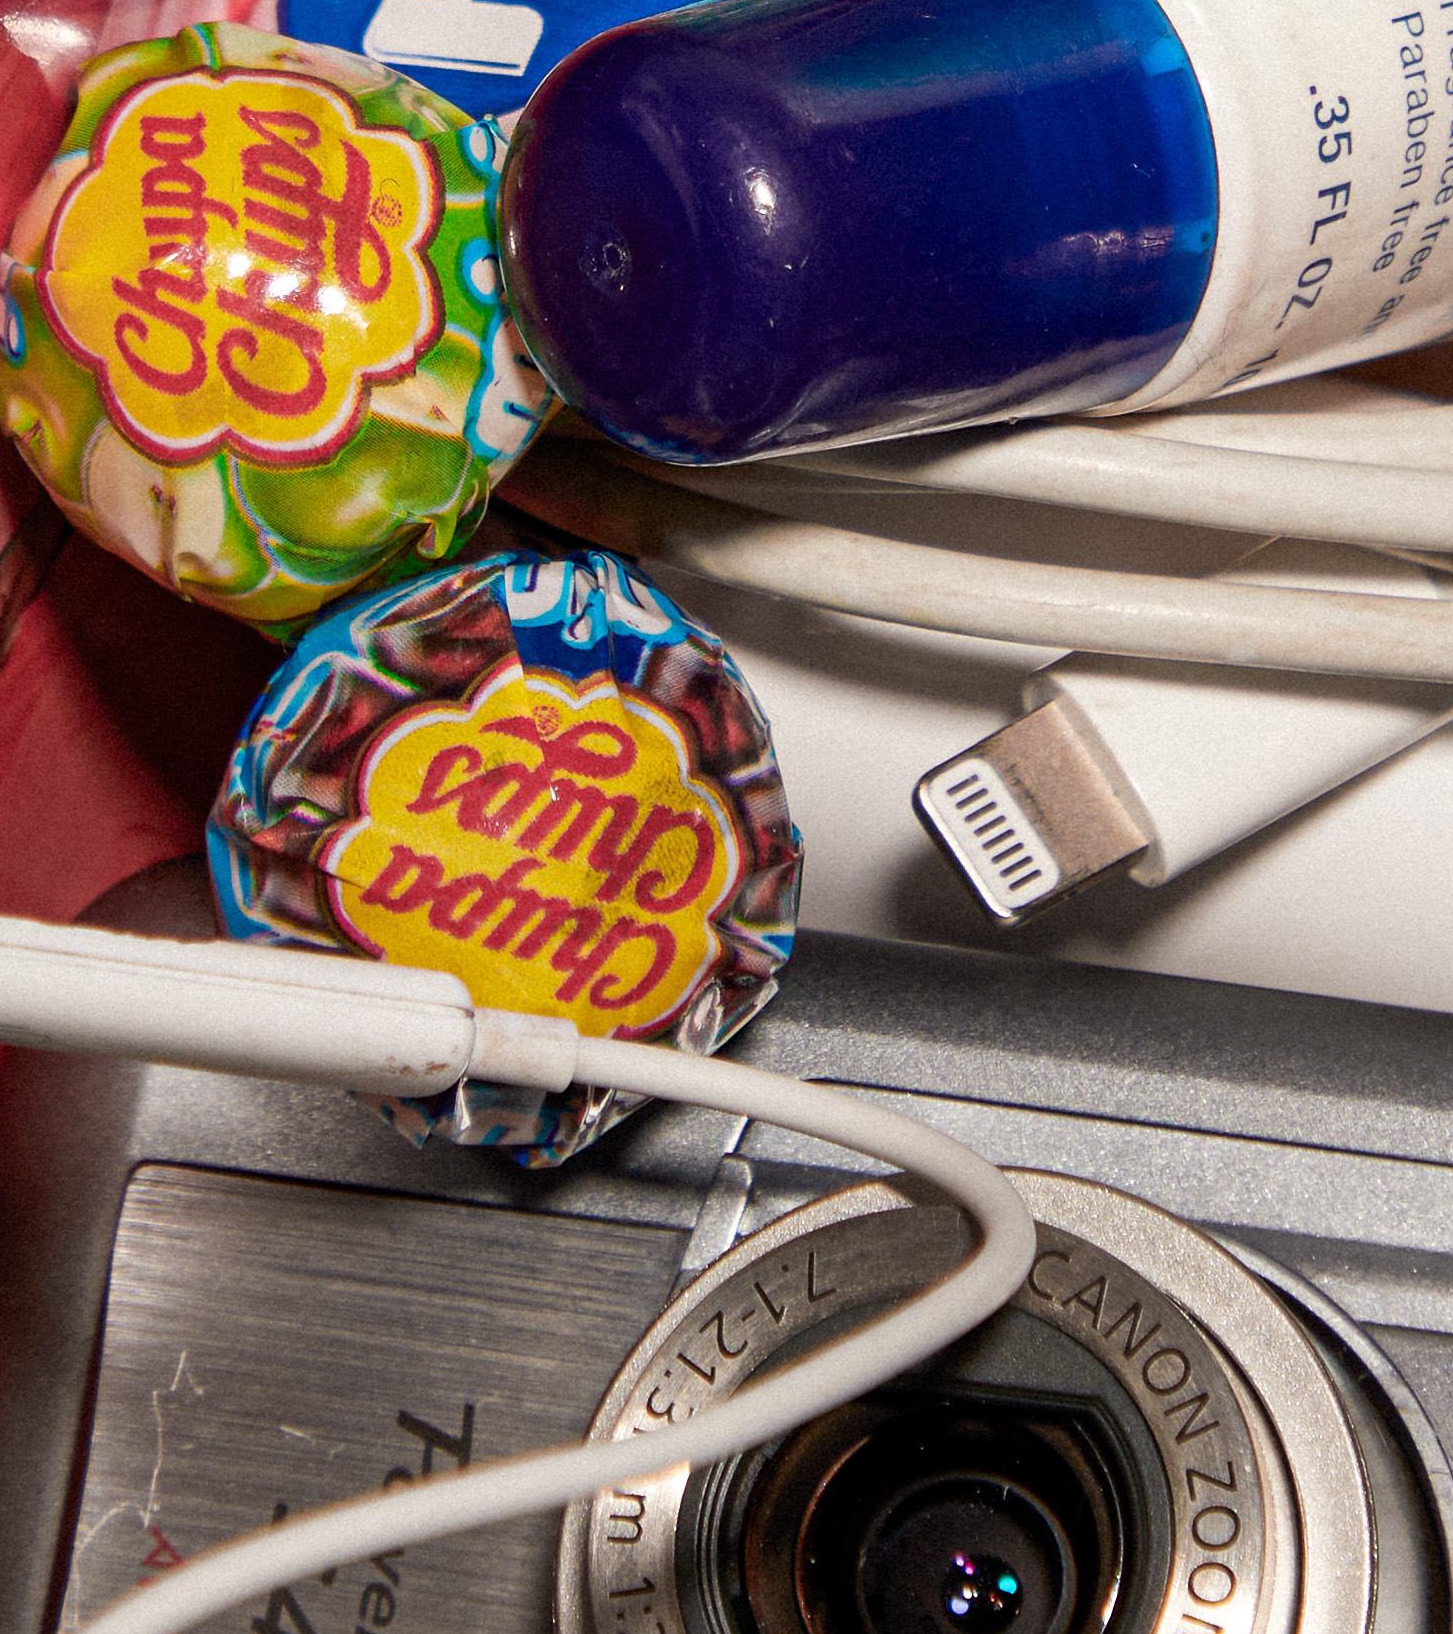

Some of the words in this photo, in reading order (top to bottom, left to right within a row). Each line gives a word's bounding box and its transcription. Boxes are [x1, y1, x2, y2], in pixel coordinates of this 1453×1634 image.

[1308, 83, 1354, 164] .35
[1390, 9, 1437, 191] Paraben
[113, 114, 212, 397] Chupa
[216, 102, 329, 418] Chups
[1275, 255, 1335, 332] OZ.
[1309, 177, 1353, 246] FL
[1369, 194, 1422, 275] free
[1397, 215, 1450, 287] free
[409, 742, 717, 918] Chups
[364, 840, 679, 1011] Chupa
[1023, 1247, 1225, 1449] CANON
